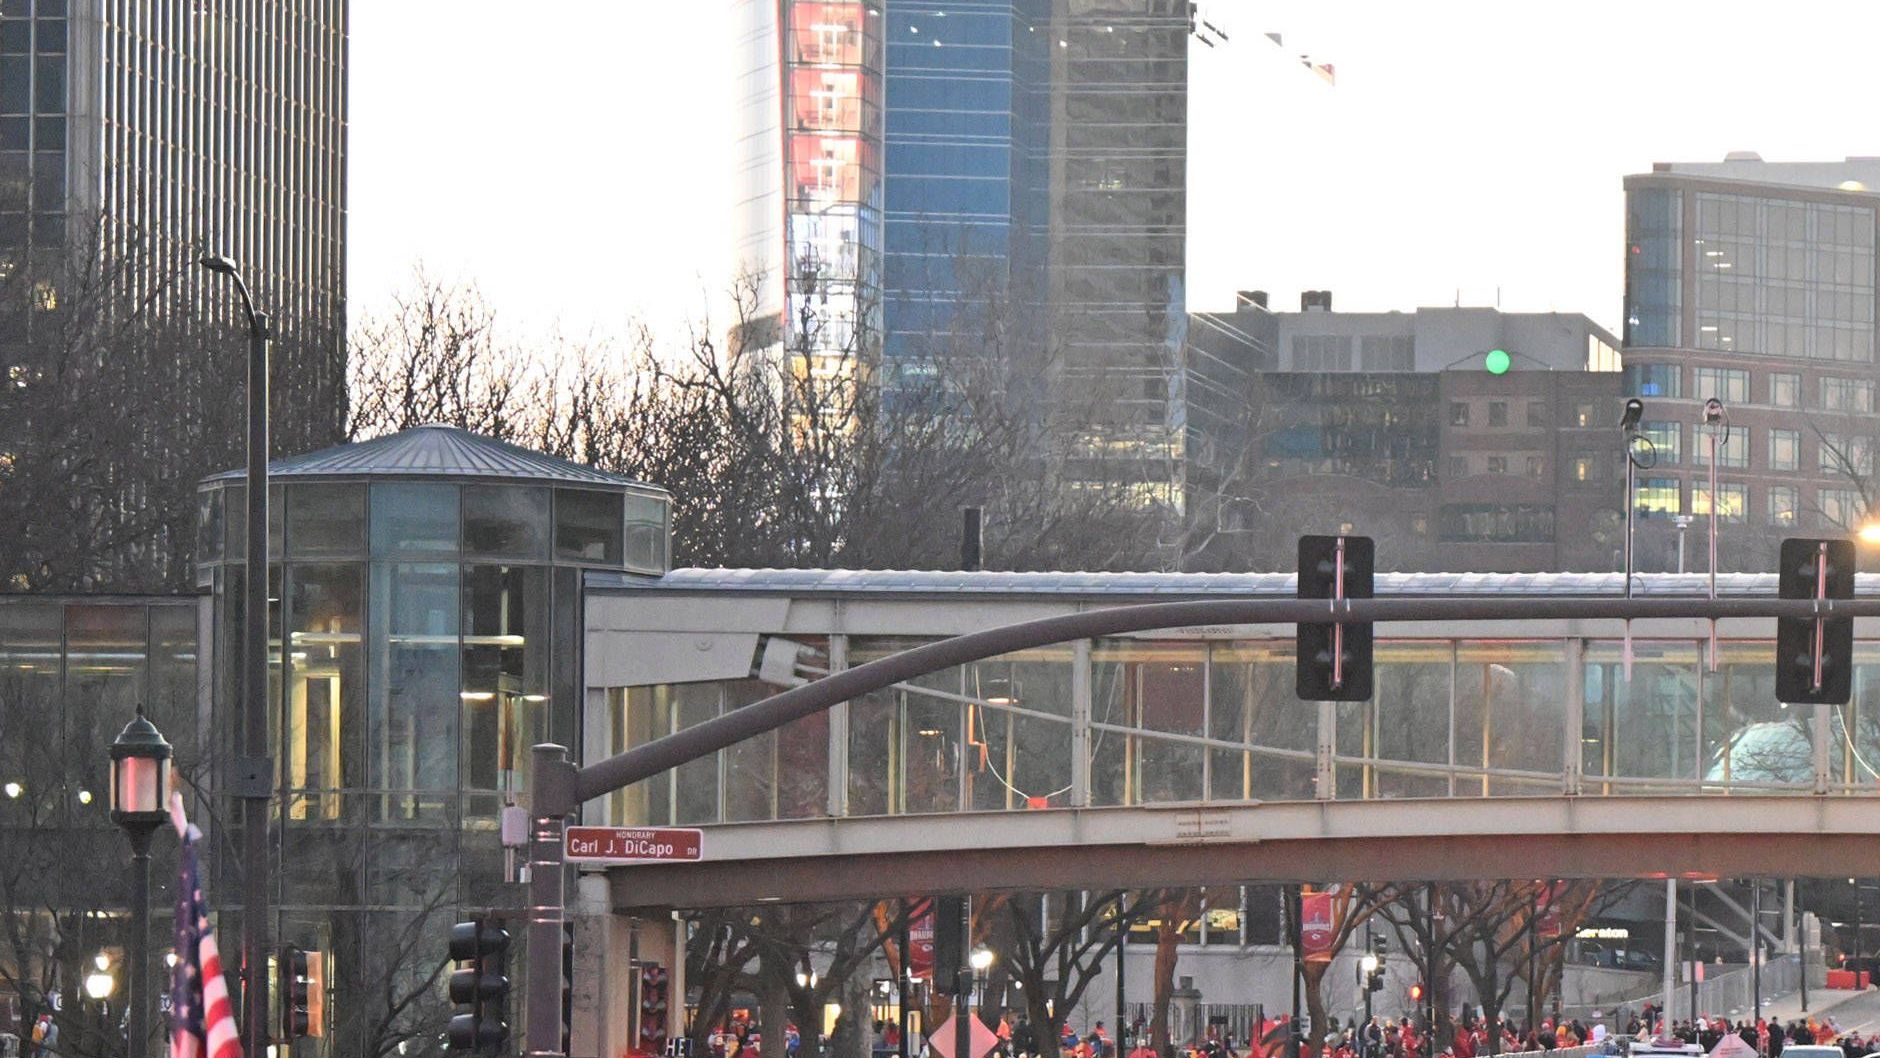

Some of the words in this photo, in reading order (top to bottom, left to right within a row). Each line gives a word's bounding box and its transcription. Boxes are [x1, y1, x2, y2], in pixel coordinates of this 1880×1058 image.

[571, 839, 599, 855] Carl
[605, 840, 619, 855] J.
[625, 840, 674, 859] DiCapo
